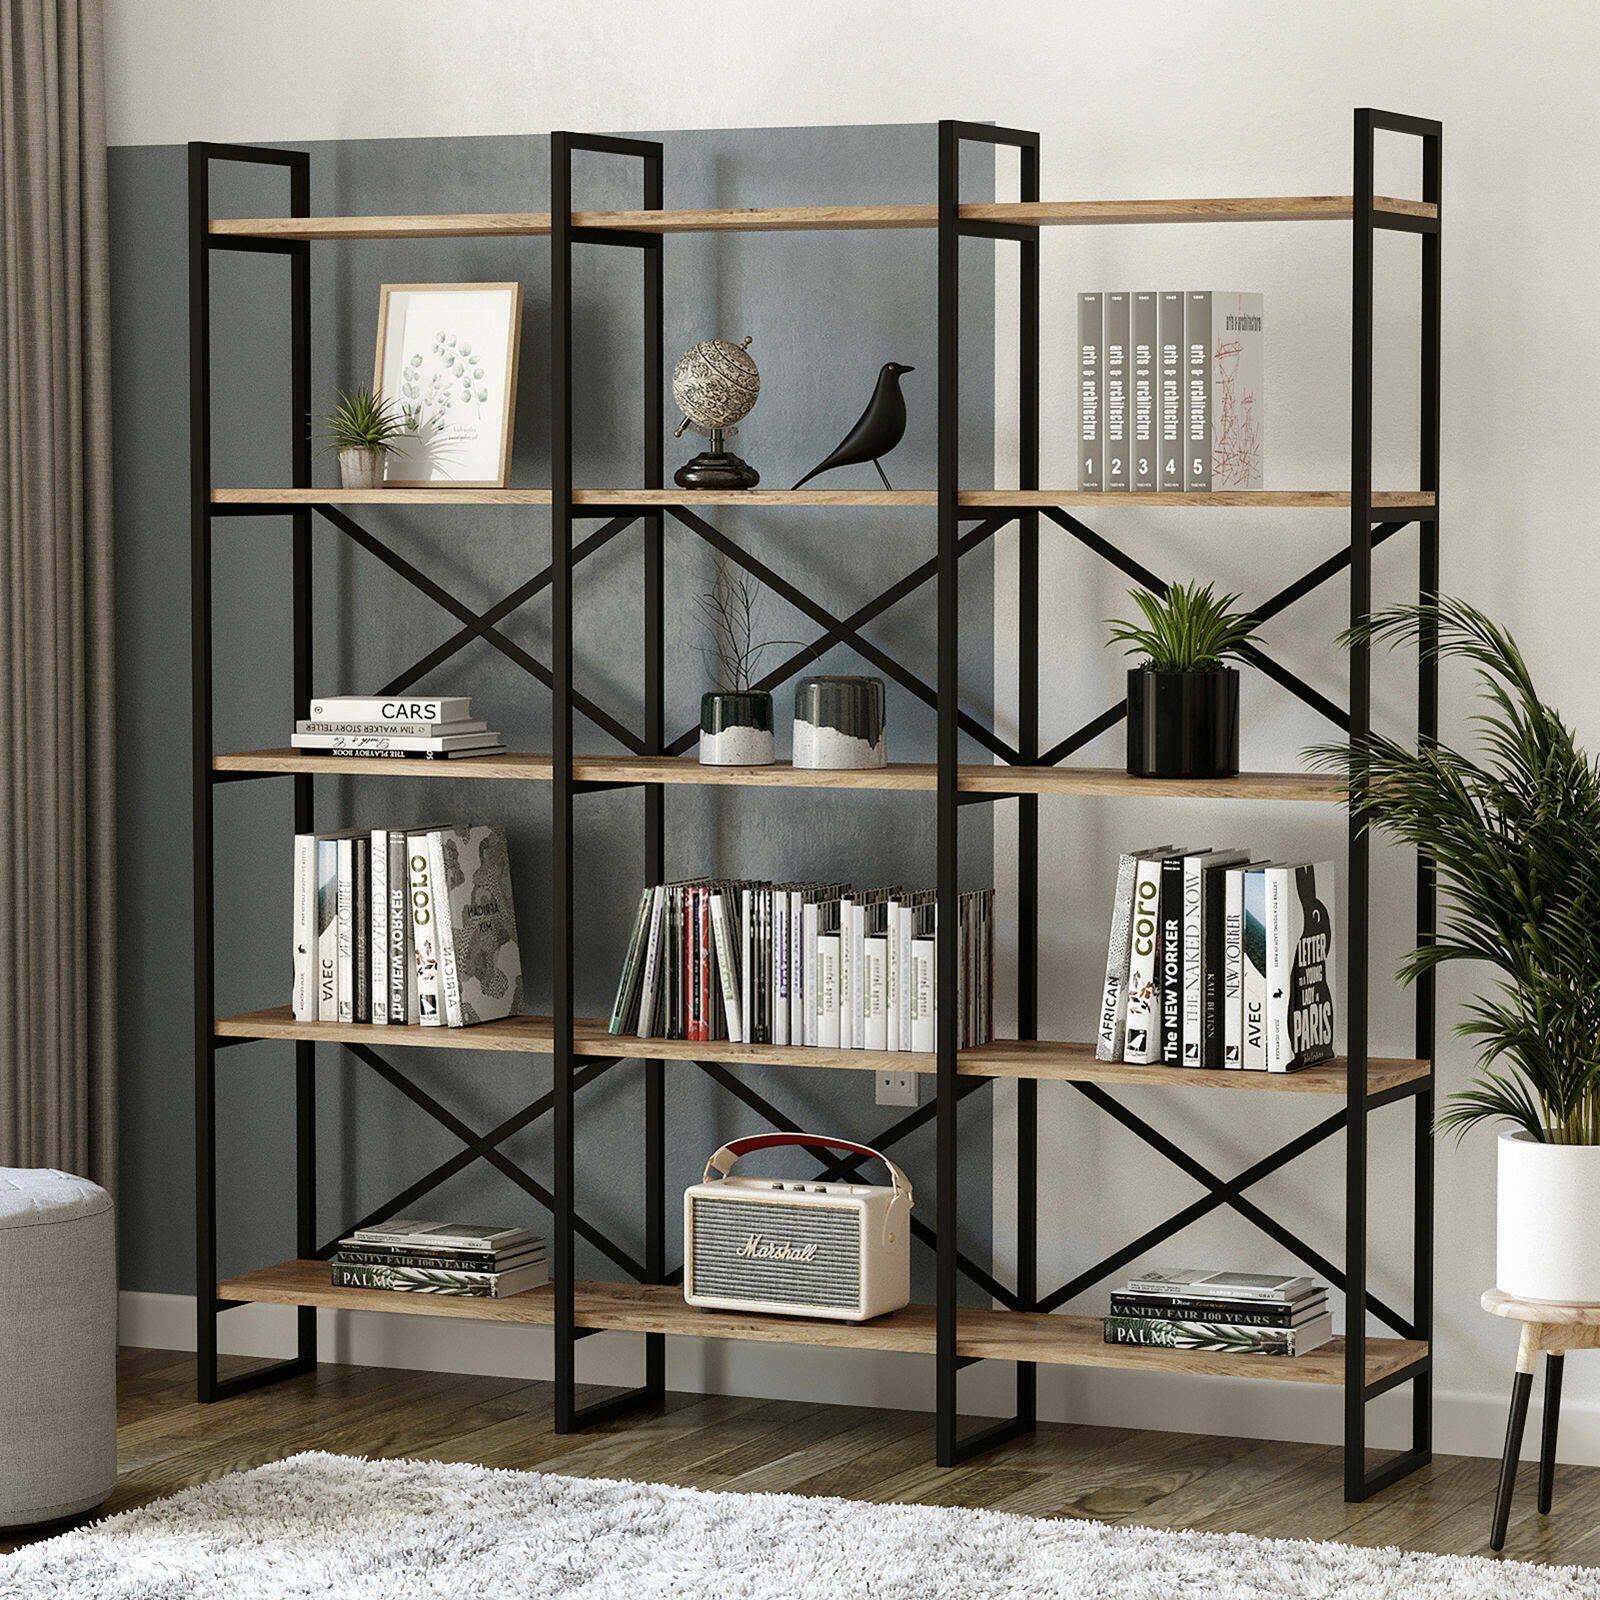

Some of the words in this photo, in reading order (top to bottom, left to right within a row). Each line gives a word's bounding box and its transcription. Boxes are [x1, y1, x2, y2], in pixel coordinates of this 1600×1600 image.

[1082, 345, 1097, 365] arts
[1109, 345, 1124, 365] arts
[1136, 345, 1151, 365] arts
[1164, 344, 1178, 365] arts
[1191, 344, 1205, 364] arts
[1082, 380, 1098, 441] architecture
[1109, 380, 1125, 441] architecture
[1136, 380, 1152, 441] architecture
[1164, 380, 1179, 441] architecture
[1191, 380, 1206, 441] architecture
[1085, 458, 1093, 474] 1
[1111, 458, 1121, 474] 2
[1138, 458, 1148, 474] 3
[1165, 458, 1176, 474] 4
[1193, 458, 1203, 474] 5
[382, 703, 436, 720] CARS
[306, 723, 334, 732] TELLER
[336, 724, 362, 733] STORY
[364, 725, 398, 734] WALKER
[400, 726, 414, 734] TIM
[332, 749, 353, 757] BOOK
[354, 750, 392, 758] PLAYBOY
[393, 750, 406, 758] THE
[1185, 870, 1200, 918] NOW
[1134, 880, 1156, 956] coro
[1164, 919, 1179, 986] YORKER
[1185, 924, 1200, 991] NAKED
[1298, 932, 1326, 968] LETTER
[1207, 973, 1215, 996] KATE
[1102, 976, 1120, 1042] AFRICAN
[1164, 990, 1178, 1028] NEW
[1186, 995, 1198, 1024] THE
[1206, 1001, 1215, 1039] BEATON
[1248, 1002, 1261, 1048] AVEC
[1294, 1000, 1332, 1054] PARIS
[1164, 1031, 1178, 1062] The
[736, 1233, 818, 1262] Marshall
[338, 1252, 382, 1263] VANITY
[387, 1255, 414, 1265] FAIR
[438, 1259, 476, 1270] YEARS
[343, 1272, 396, 1288] PALMS
[1172, 1298, 1190, 1306] Dior
[1112, 1306, 1164, 1317] VANITY
[1167, 1309, 1198, 1320] FAIR
[1202, 1312, 1222, 1321] 100
[1225, 1314, 1270, 1324] YEARS
[1117, 1327, 1177, 1346] PALMS
